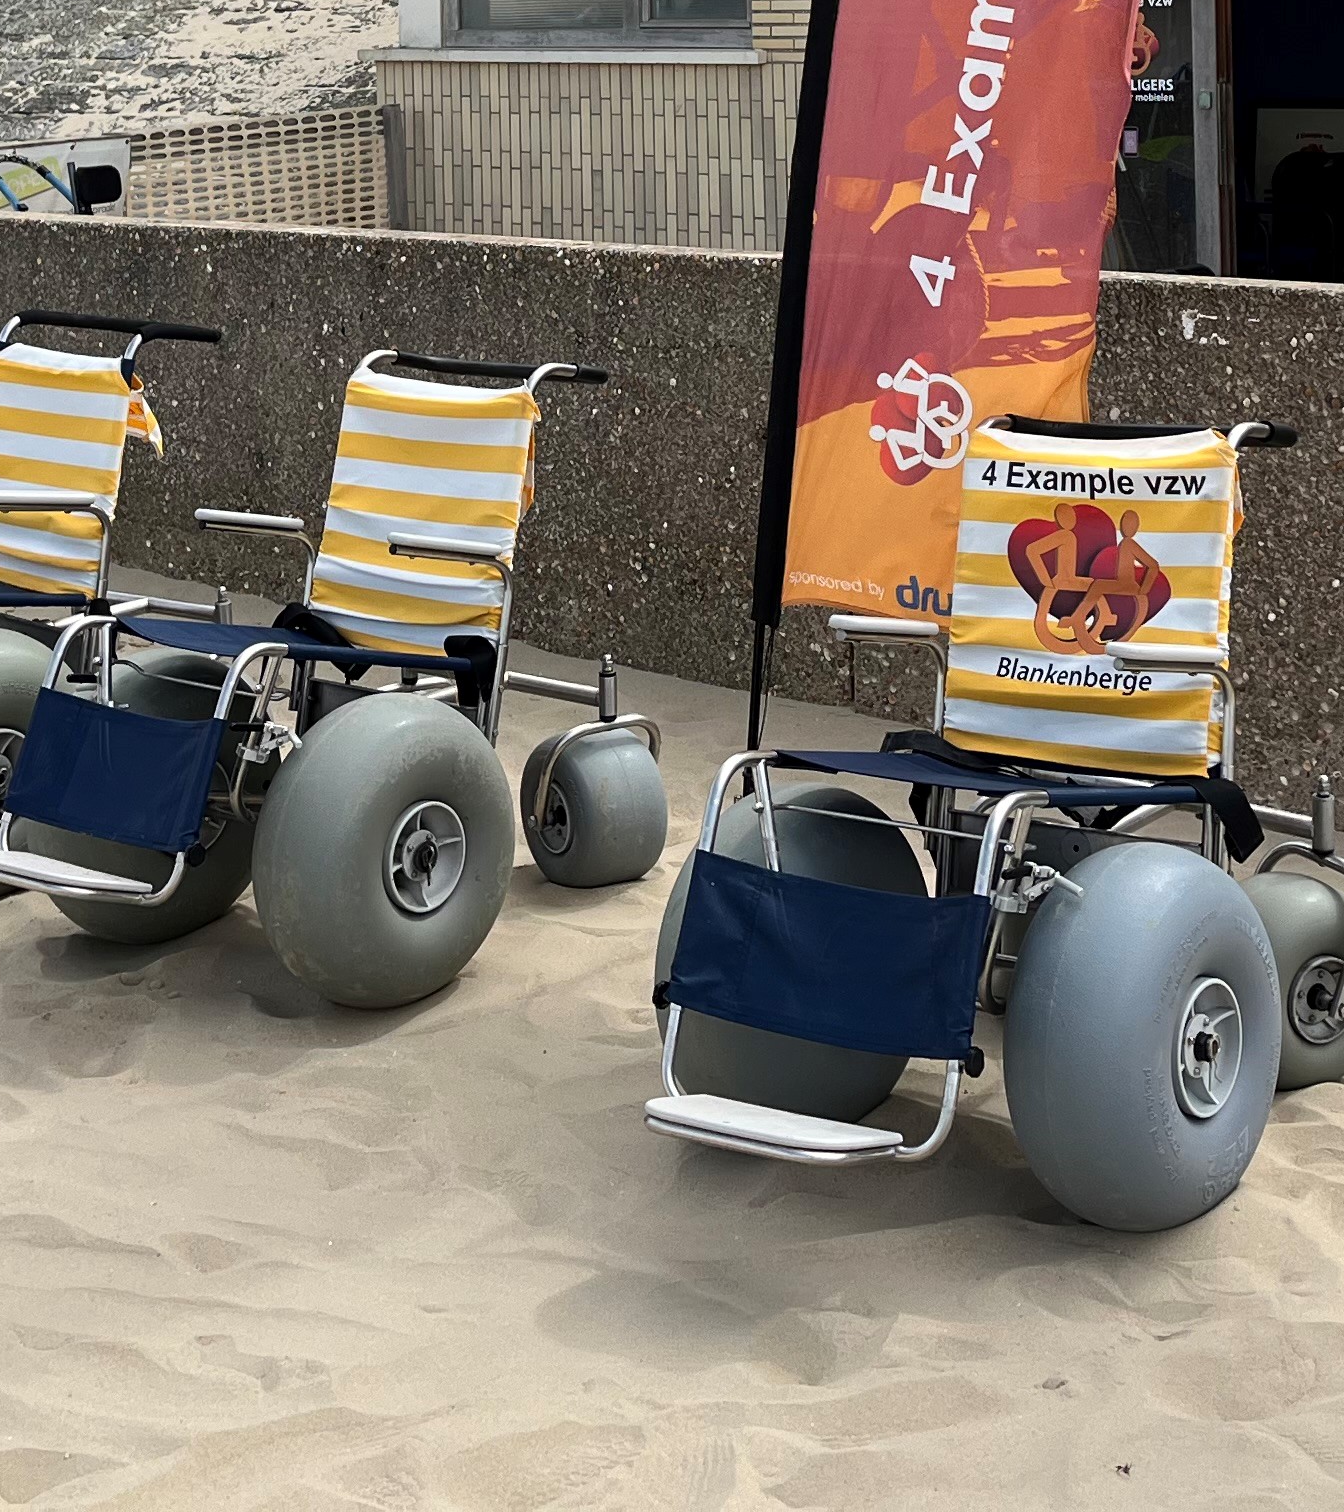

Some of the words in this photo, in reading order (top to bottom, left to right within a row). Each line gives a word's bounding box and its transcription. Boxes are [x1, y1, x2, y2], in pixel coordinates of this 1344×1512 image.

[909, 254, 955, 307] 4
[981, 460, 998, 486] 4
[1006, 461, 1134, 499] Example
[1144, 473, 1207, 495] vzw
[789, 571, 862, 593] sponsored
[868, 579, 886, 601] by
[996, 656, 1152, 696] Blankenberge
